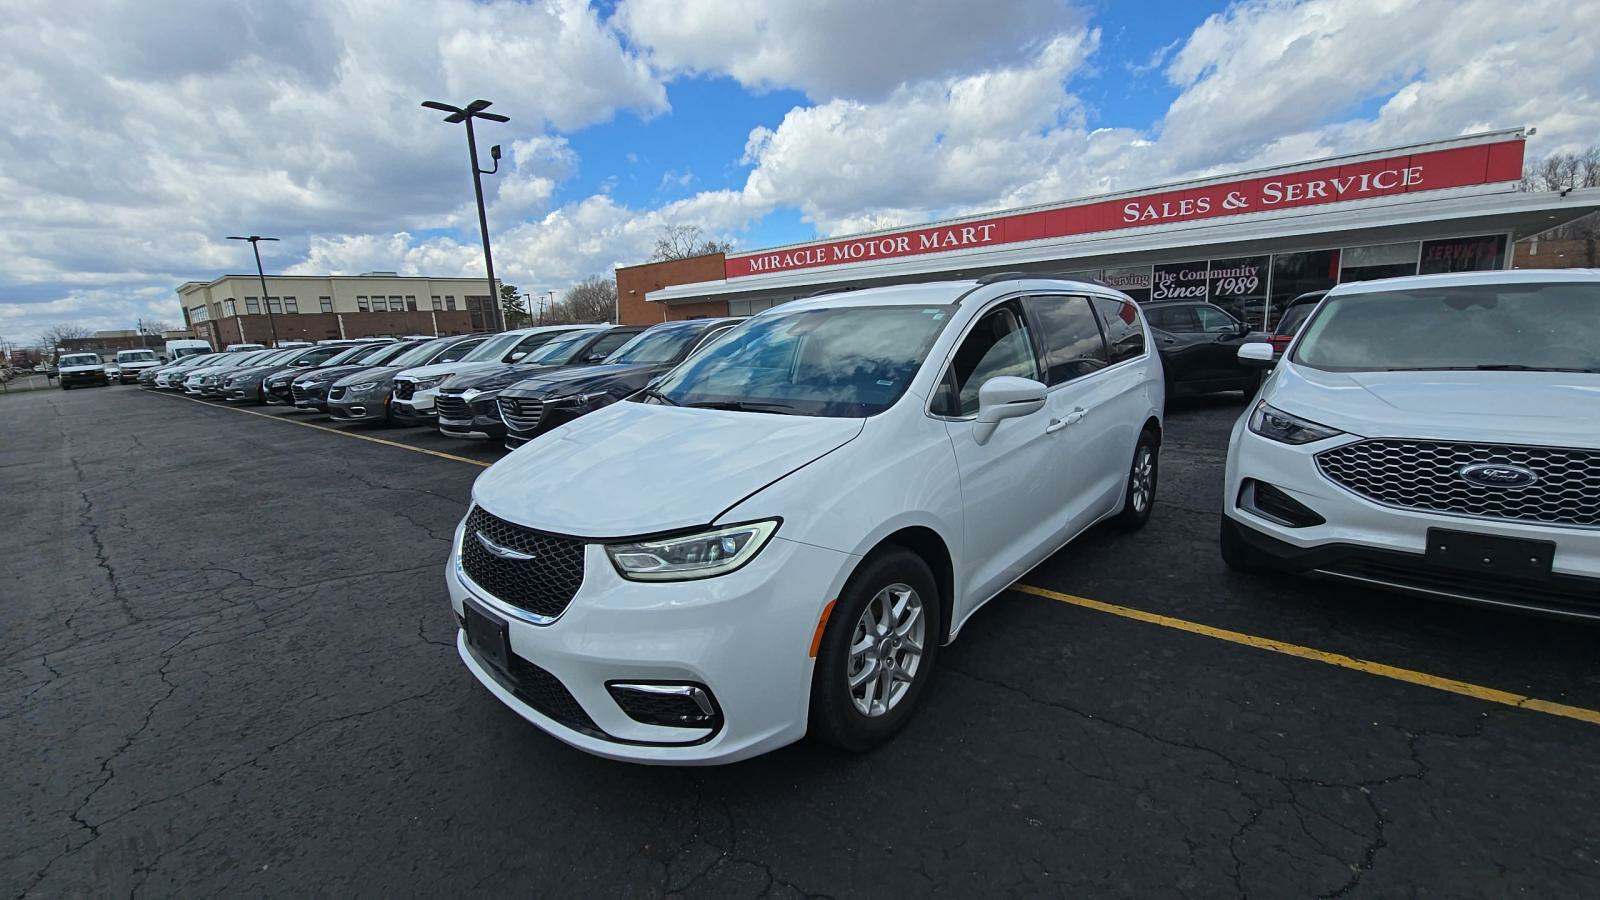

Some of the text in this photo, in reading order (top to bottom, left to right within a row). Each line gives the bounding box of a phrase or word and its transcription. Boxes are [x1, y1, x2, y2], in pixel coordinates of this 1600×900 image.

[1122, 166, 1425, 223] SALES & SERVICE
[750, 223, 996, 272] MIRACLE MOTOR MART
[1106, 264, 1259, 288] Serving The Community
[1153, 276, 1259, 299] Since 1989
[1482, 468, 1519, 481] Ford
